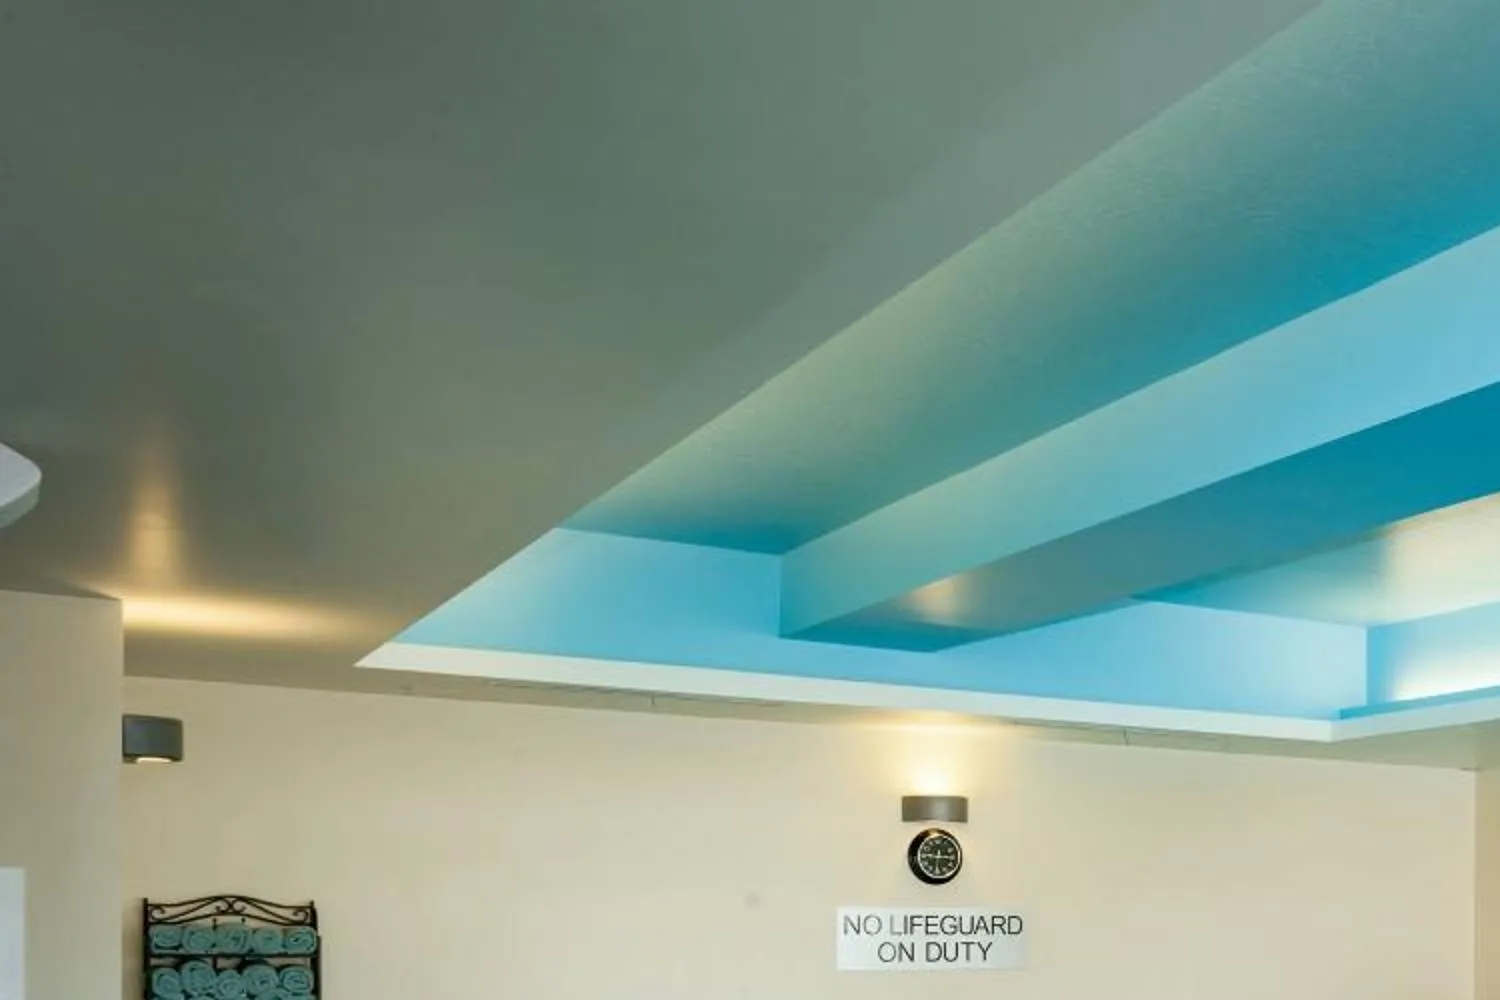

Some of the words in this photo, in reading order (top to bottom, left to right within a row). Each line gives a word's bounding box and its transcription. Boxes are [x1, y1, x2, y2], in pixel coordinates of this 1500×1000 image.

[843, 914, 882, 936] NO
[889, 915, 1023, 936] LIFEGUARD
[877, 941, 915, 963] ON
[924, 941, 993, 963] DUTY
